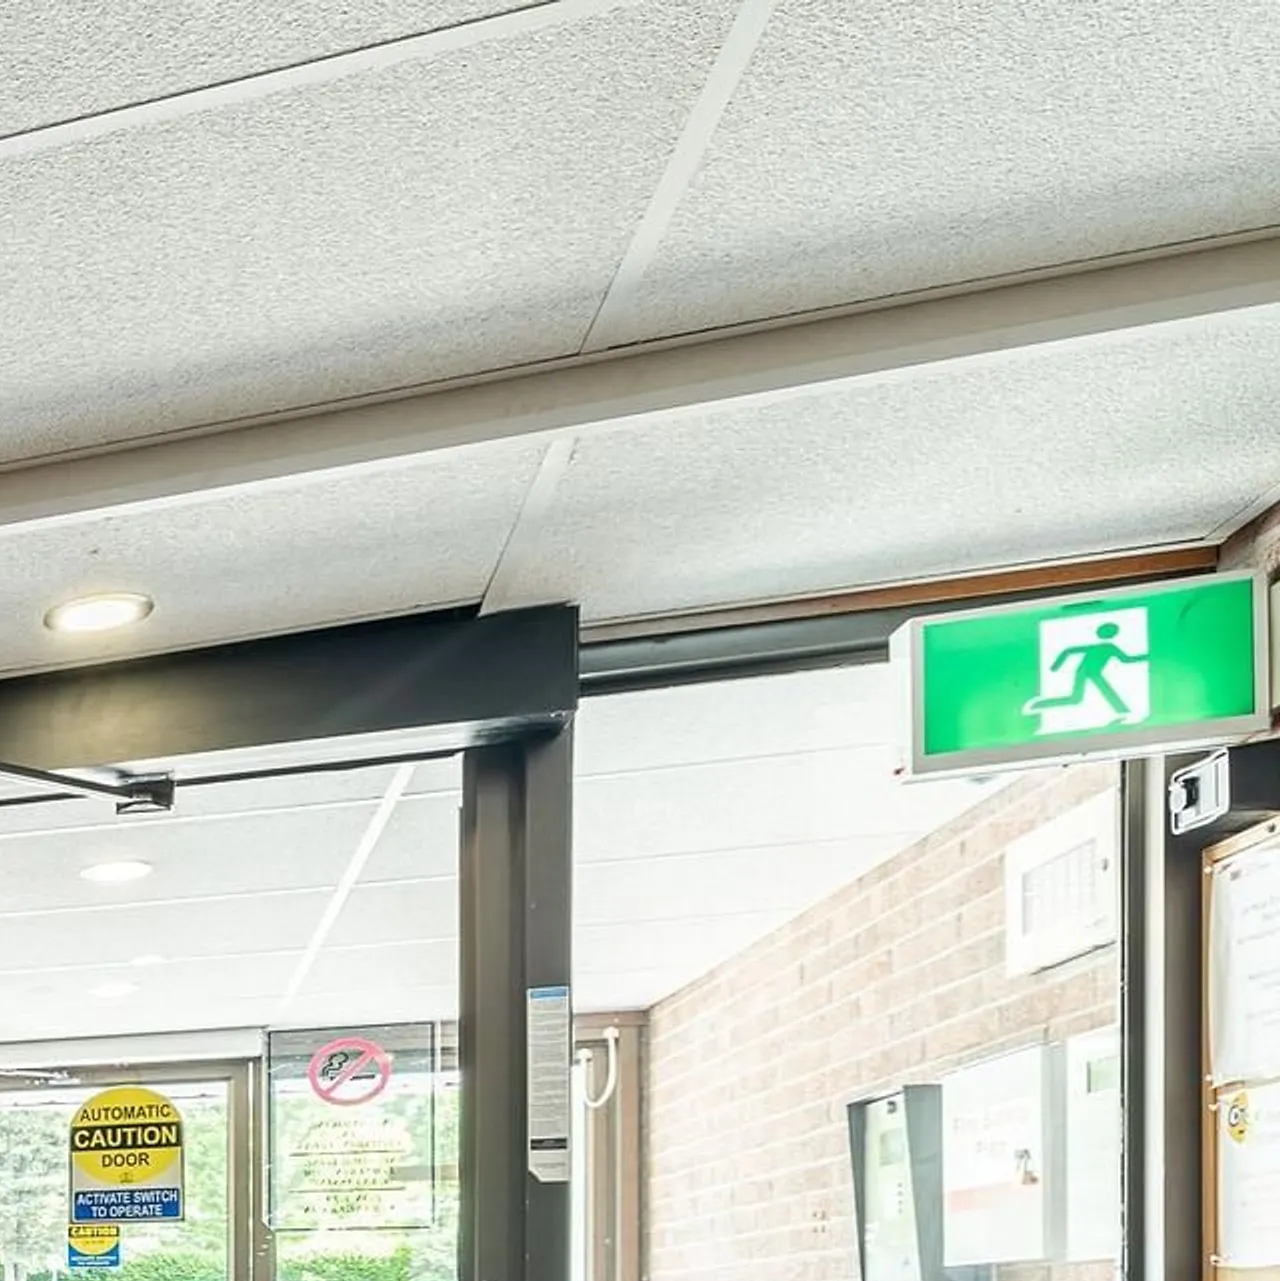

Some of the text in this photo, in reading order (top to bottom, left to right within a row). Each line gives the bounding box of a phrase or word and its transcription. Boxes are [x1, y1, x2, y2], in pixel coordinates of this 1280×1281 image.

[80, 1104, 172, 1123] AUTOMATIC
[74, 1125, 178, 1149] CAUTION
[101, 1152, 151, 1168] DOOR
[76, 1190, 178, 1206] ACTIVATE SWITCH
[91, 1204, 164, 1218] TO OPERATE
